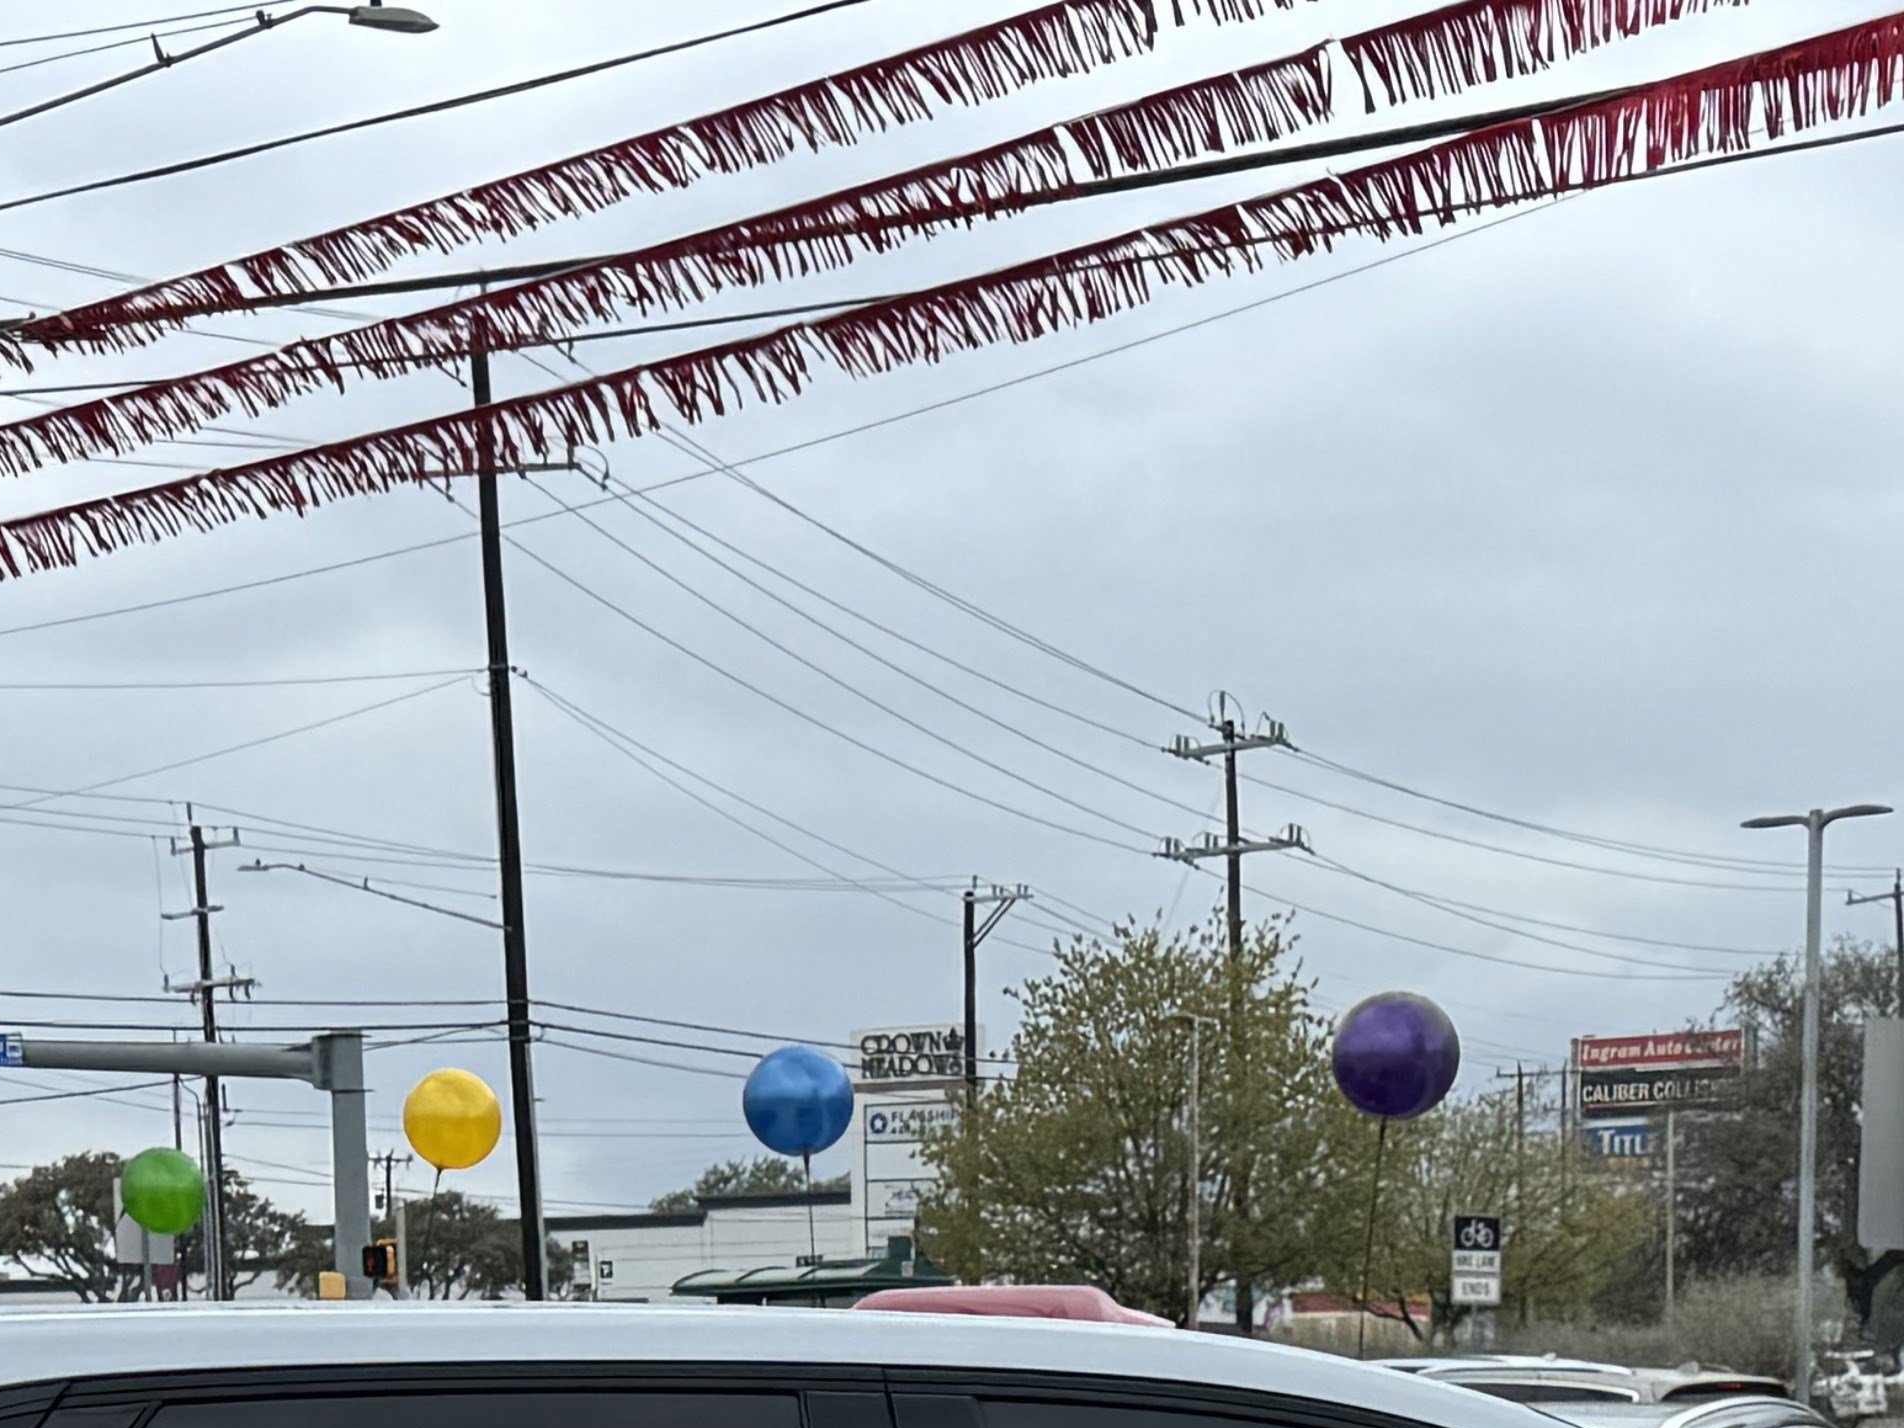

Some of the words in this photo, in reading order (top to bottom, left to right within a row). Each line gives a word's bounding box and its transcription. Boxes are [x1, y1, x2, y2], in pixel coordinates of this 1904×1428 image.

[861, 1031, 942, 1055] CROWN
[1583, 1044, 1641, 1062] Ingram
[1644, 1040, 1682, 1057] Auto
[1583, 1082, 1649, 1103] CALIBER
